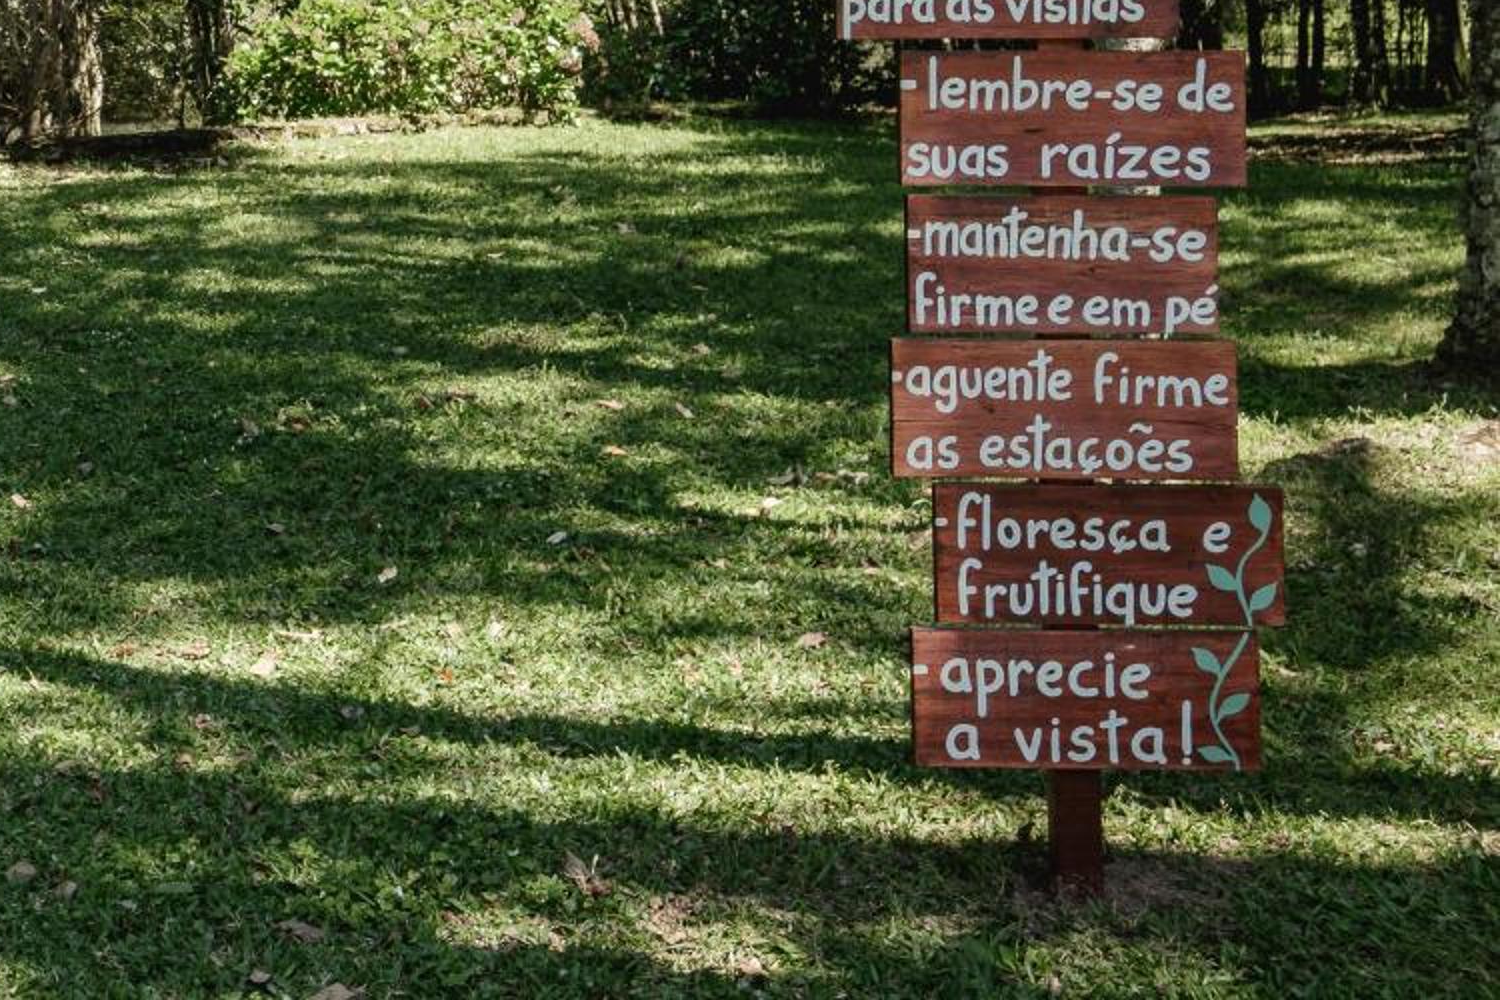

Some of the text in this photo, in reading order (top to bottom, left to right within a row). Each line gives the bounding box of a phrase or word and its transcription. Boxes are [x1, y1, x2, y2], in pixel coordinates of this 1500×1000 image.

[1176, 57, 1236, 113] de
[906, 131, 1212, 182] suas raízes
[913, 271, 1219, 341] firme e em pé
[1093, 351, 1230, 408] firme
[905, 434, 960, 470] as
[1201, 520, 1233, 554] e
[956, 558, 1198, 626] frutifique
[945, 699, 1194, 766] a vista!
